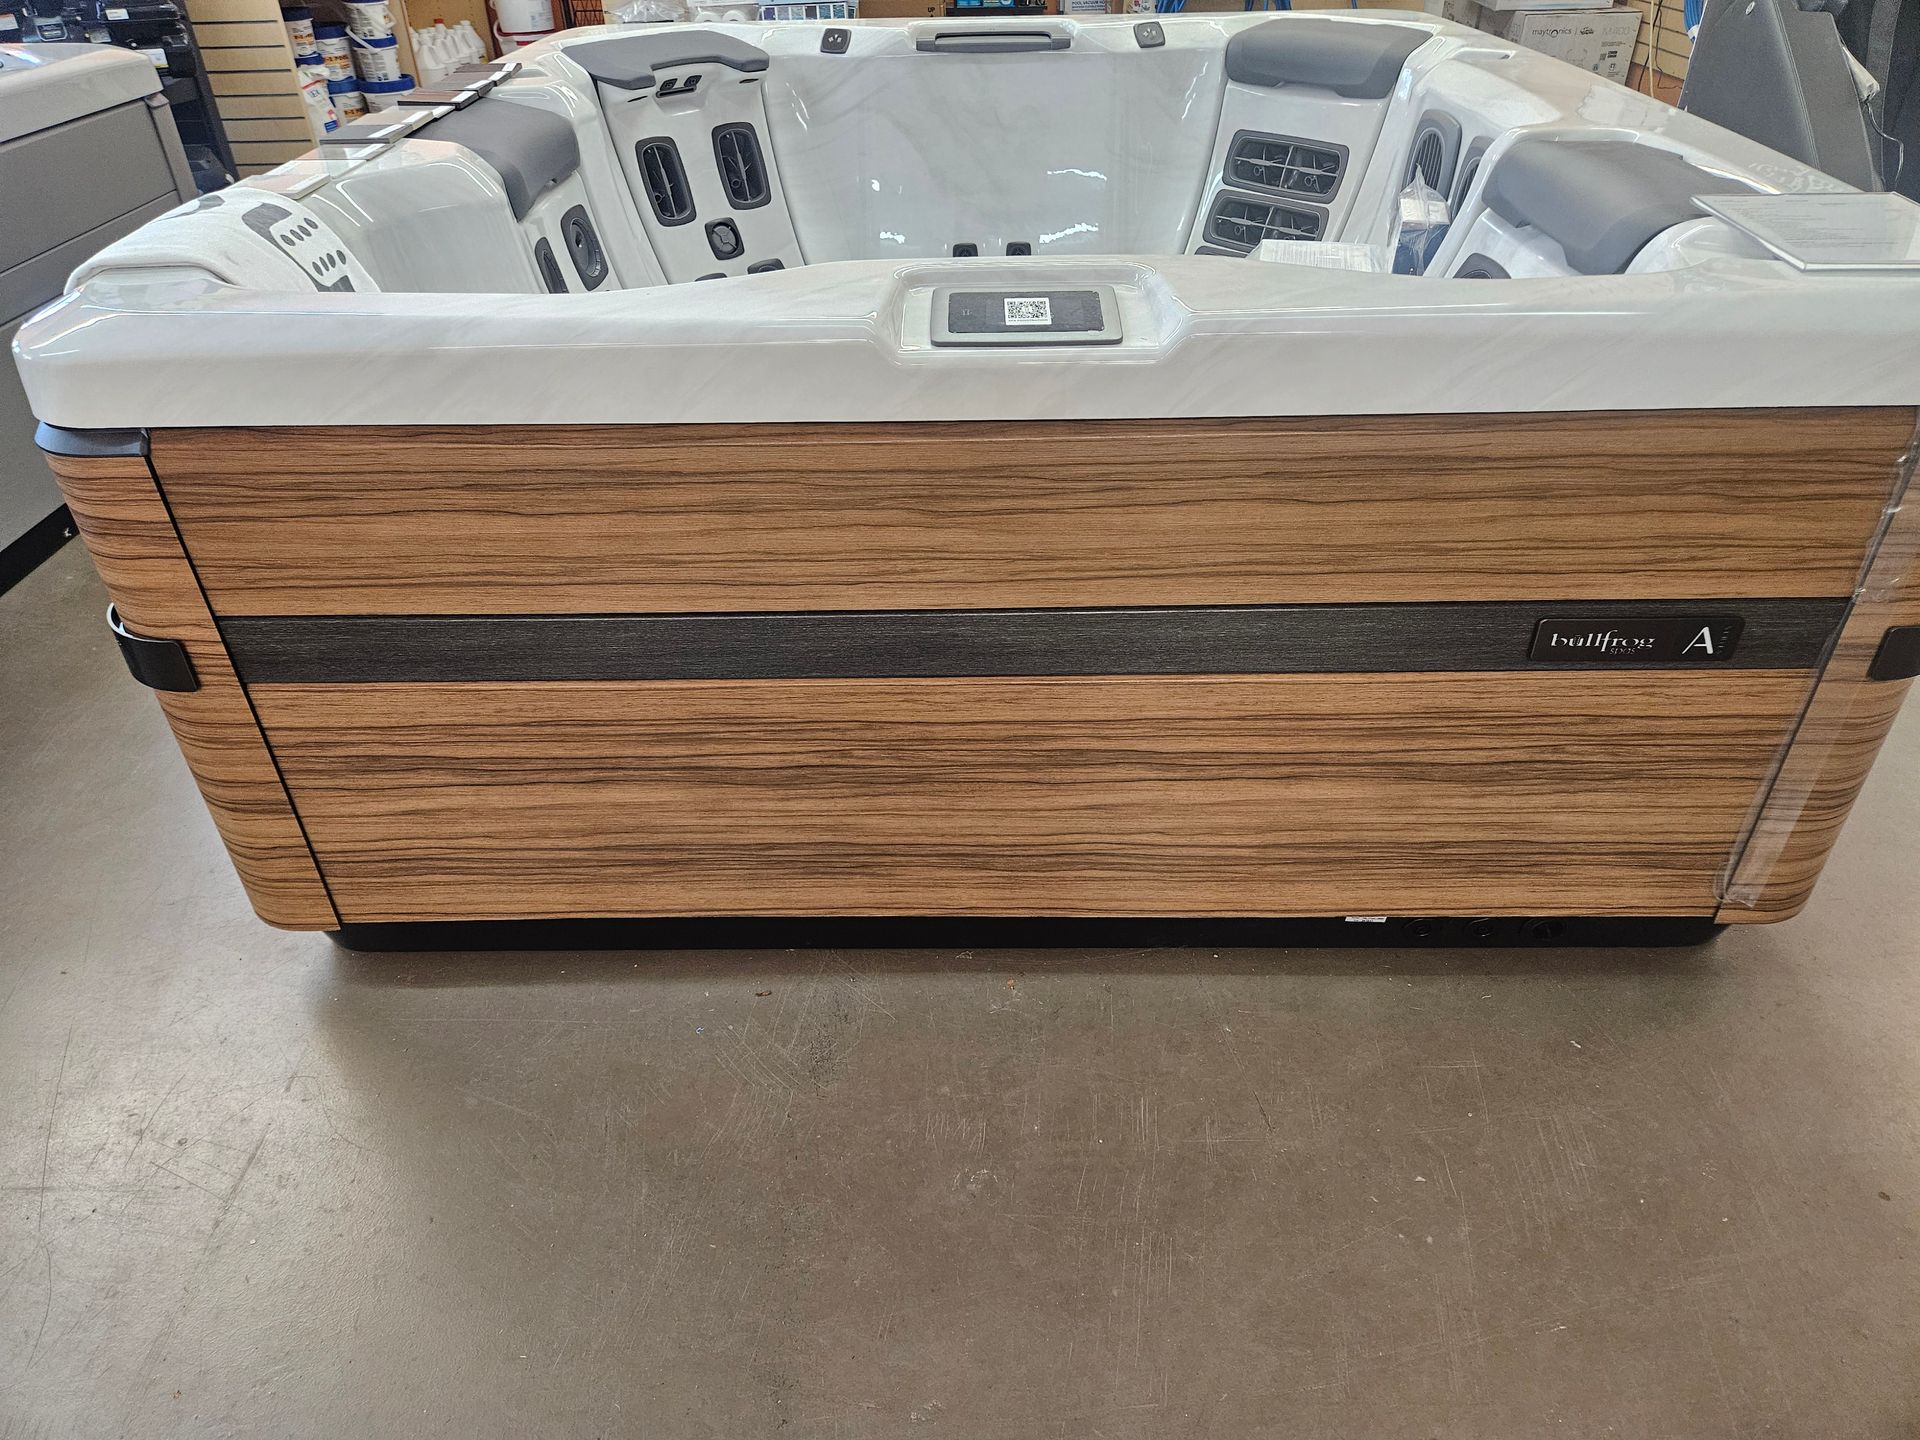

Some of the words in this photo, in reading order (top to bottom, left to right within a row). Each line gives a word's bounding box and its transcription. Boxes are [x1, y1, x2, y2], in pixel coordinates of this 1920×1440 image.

[1532, 24, 1572, 38] maytronics
[1550, 629, 1656, 652] bullfrog
[1682, 626, 1714, 655] A
